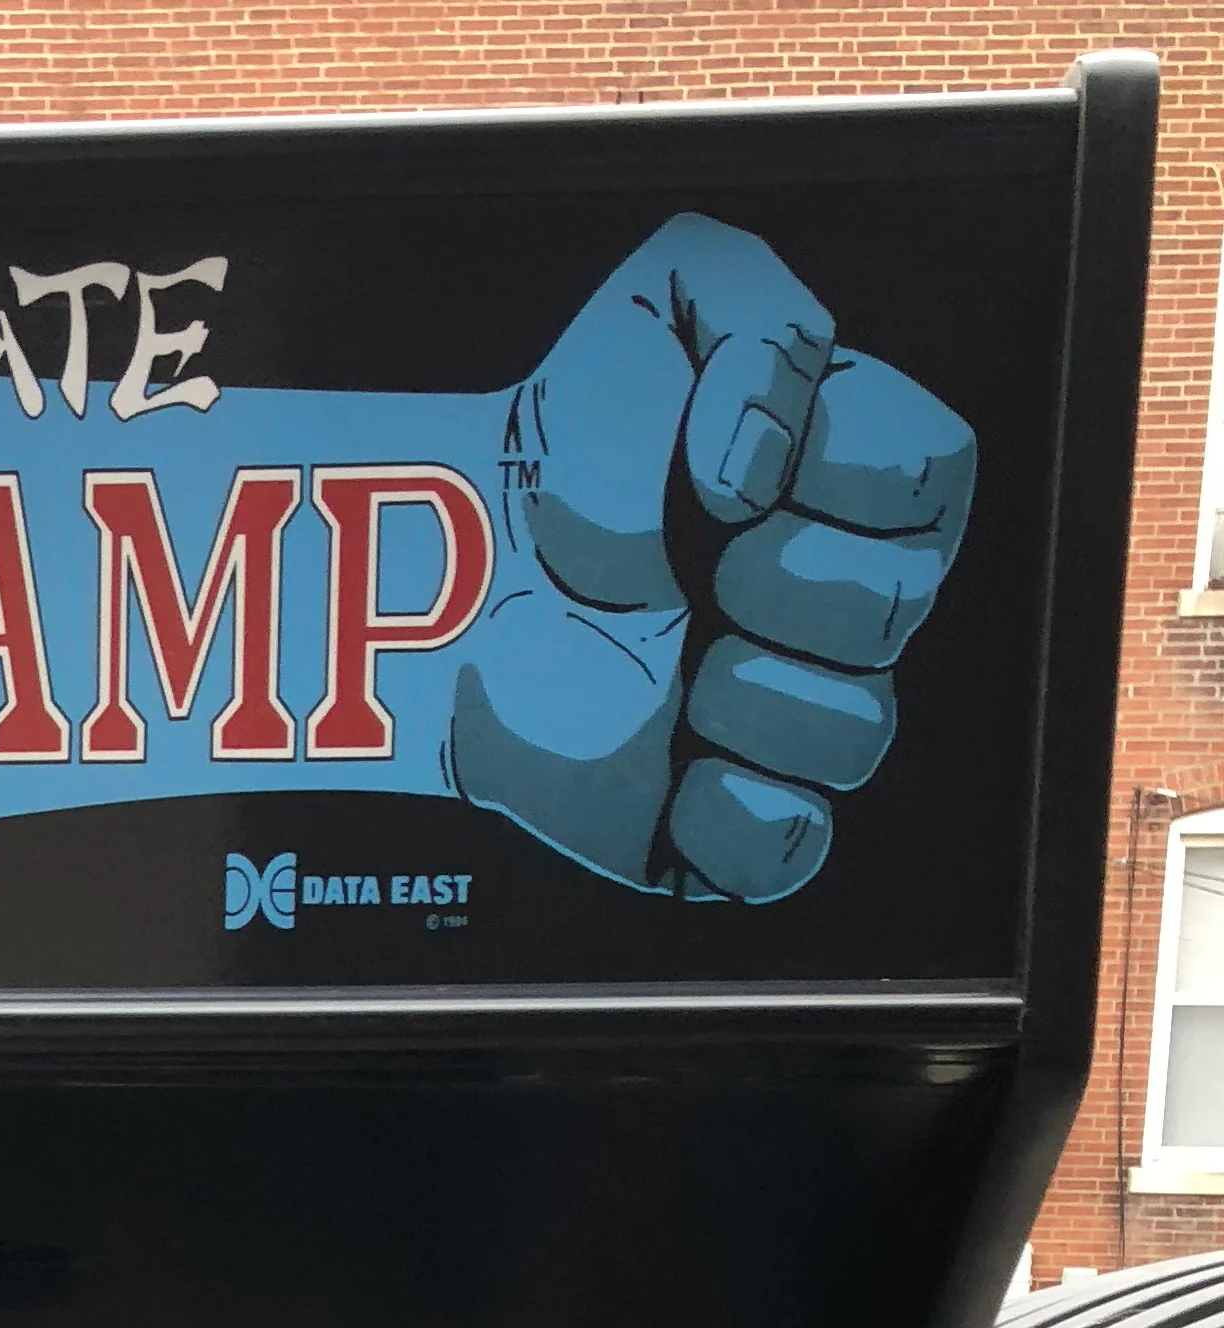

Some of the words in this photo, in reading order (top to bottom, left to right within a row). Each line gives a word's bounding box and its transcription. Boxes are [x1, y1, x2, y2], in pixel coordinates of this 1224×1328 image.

[497, 460, 540, 489] TM
[302, 875, 381, 905] DATA
[391, 875, 472, 905] EAST
